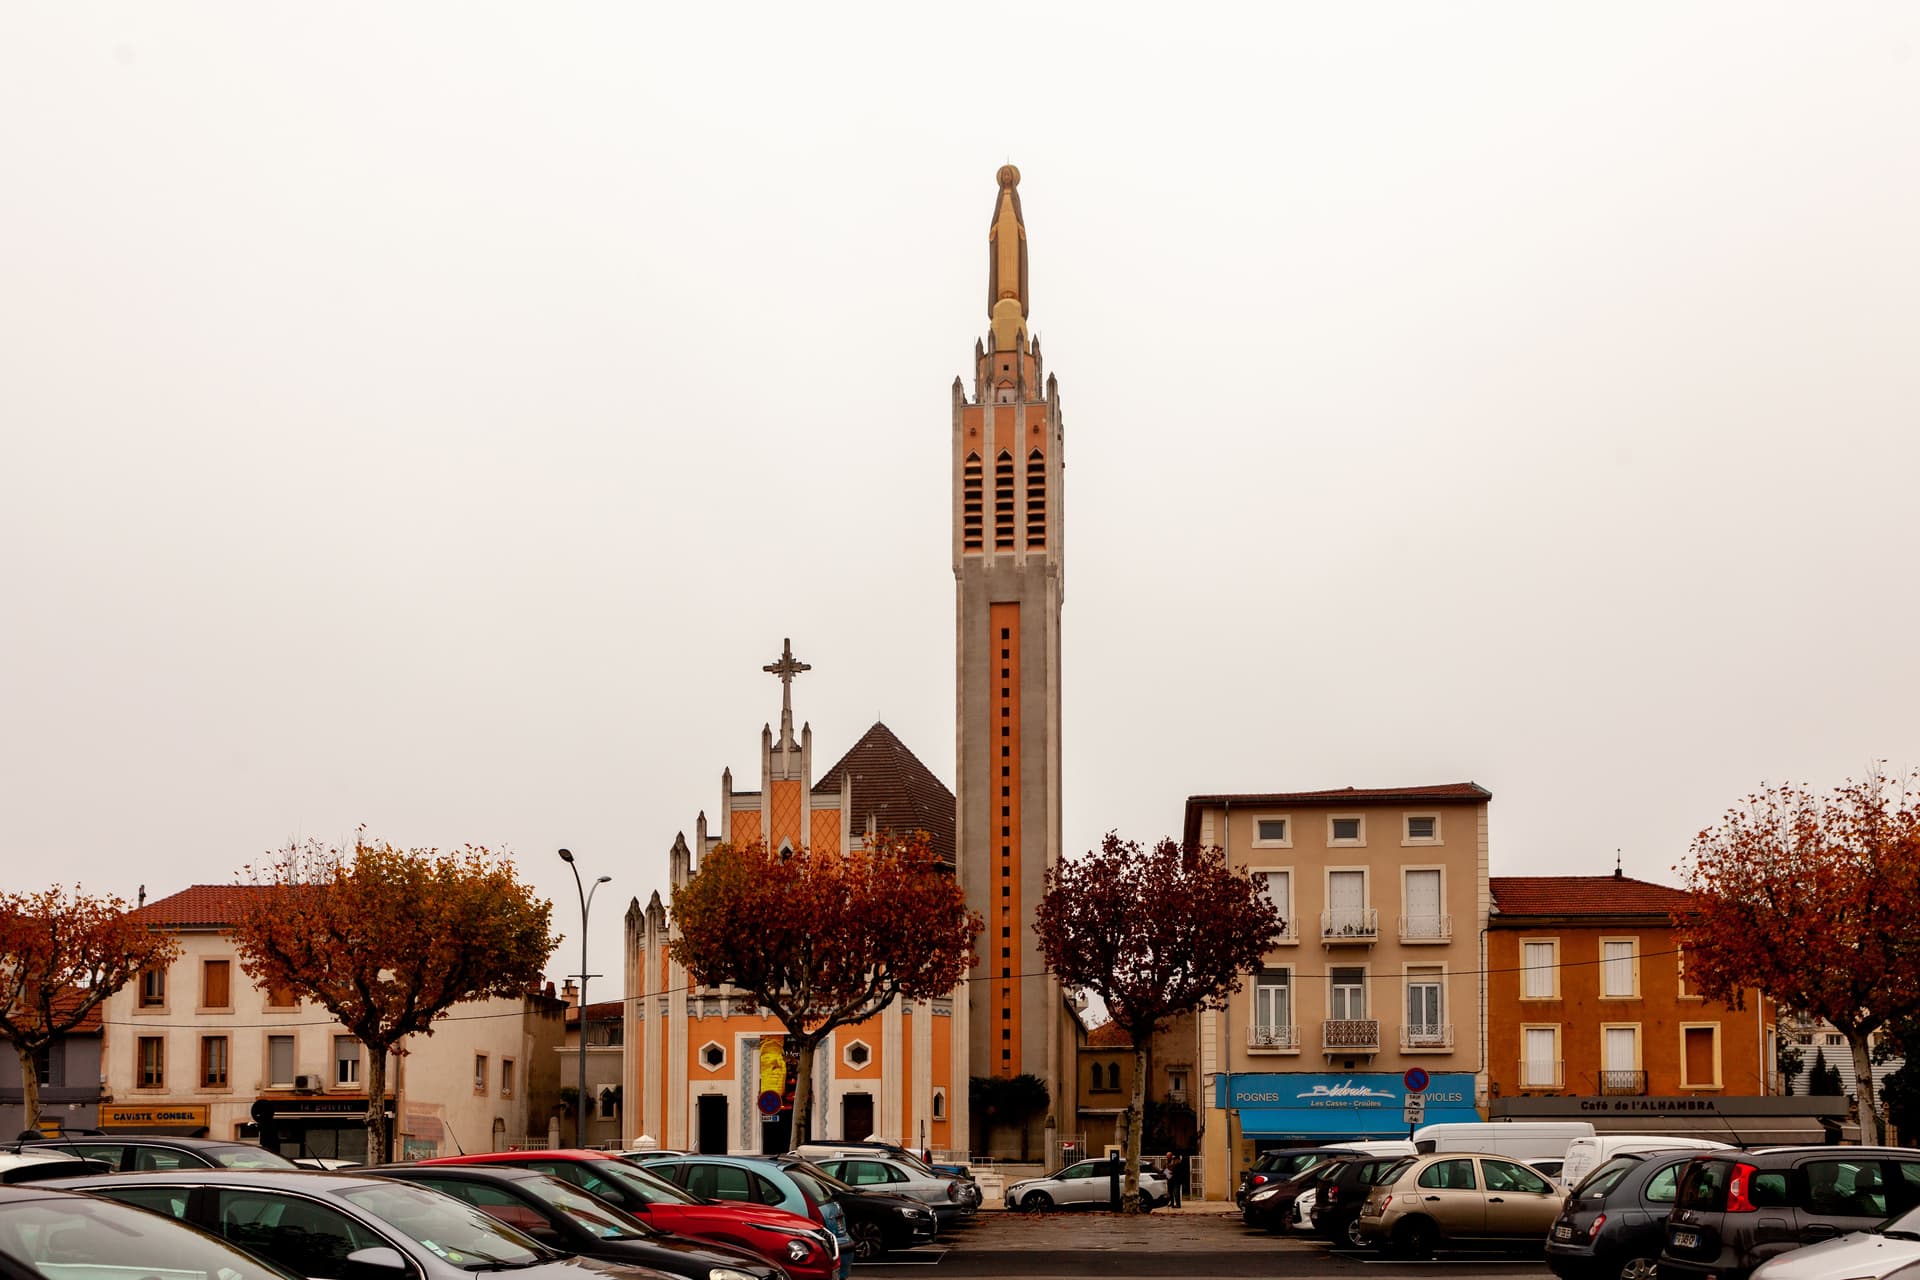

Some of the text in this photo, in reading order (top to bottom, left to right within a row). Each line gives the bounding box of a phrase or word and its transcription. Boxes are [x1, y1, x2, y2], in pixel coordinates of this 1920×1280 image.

[1236, 1092, 1279, 1101] POGNES
[1581, 1100, 1715, 1110] Café de l'ALHAMBRA
[1111, 1152, 1117, 1160] P
